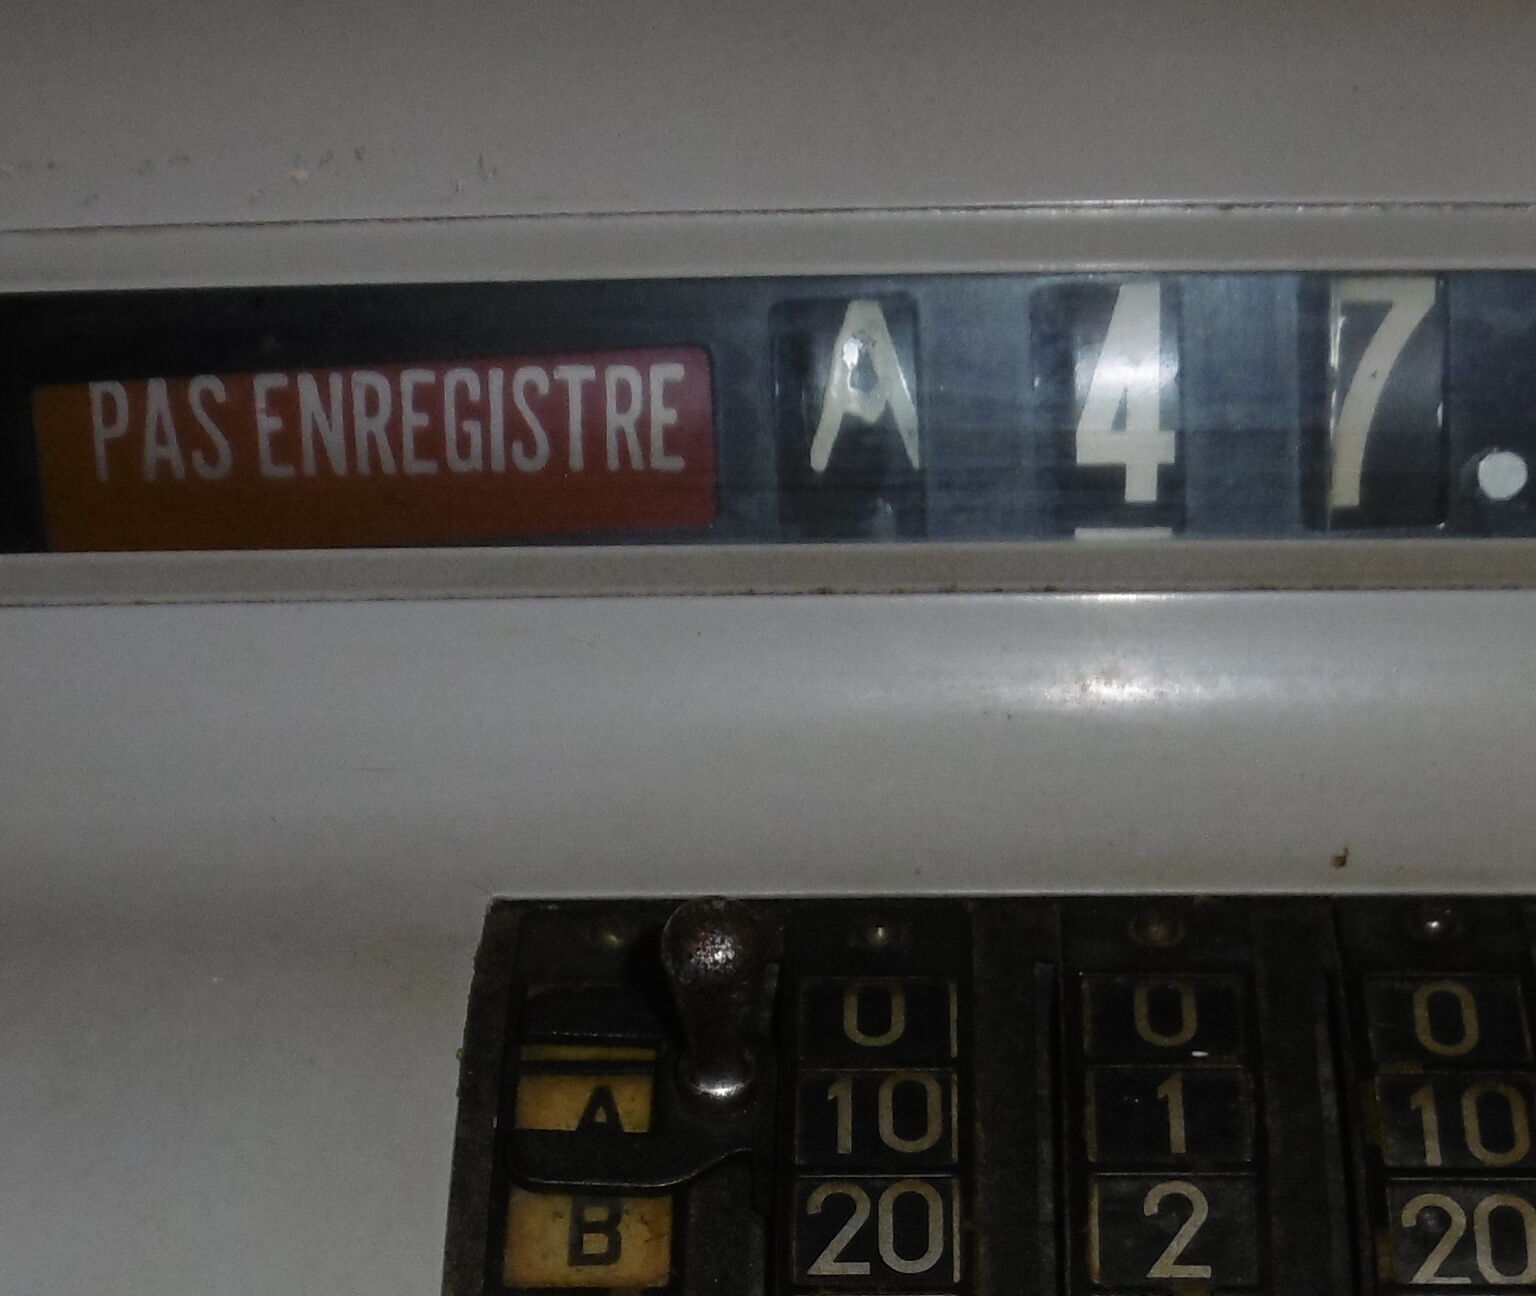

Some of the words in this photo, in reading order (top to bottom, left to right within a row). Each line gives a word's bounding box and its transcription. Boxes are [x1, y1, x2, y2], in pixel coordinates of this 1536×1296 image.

[89, 374, 236, 483] PAS
[256, 362, 685, 478] ENREGISTRE
[842, 985, 907, 1047] 0
[1133, 983, 1199, 1047] 0
[1412, 980, 1480, 1057] 0
[826, 1072, 943, 1154] 10
[1156, 1073, 1186, 1155] 1
[1408, 1080, 1532, 1168] 10
[568, 1198, 623, 1267] B
[806, 1178, 946, 1277] 20
[1142, 1180, 1213, 1279] 2
